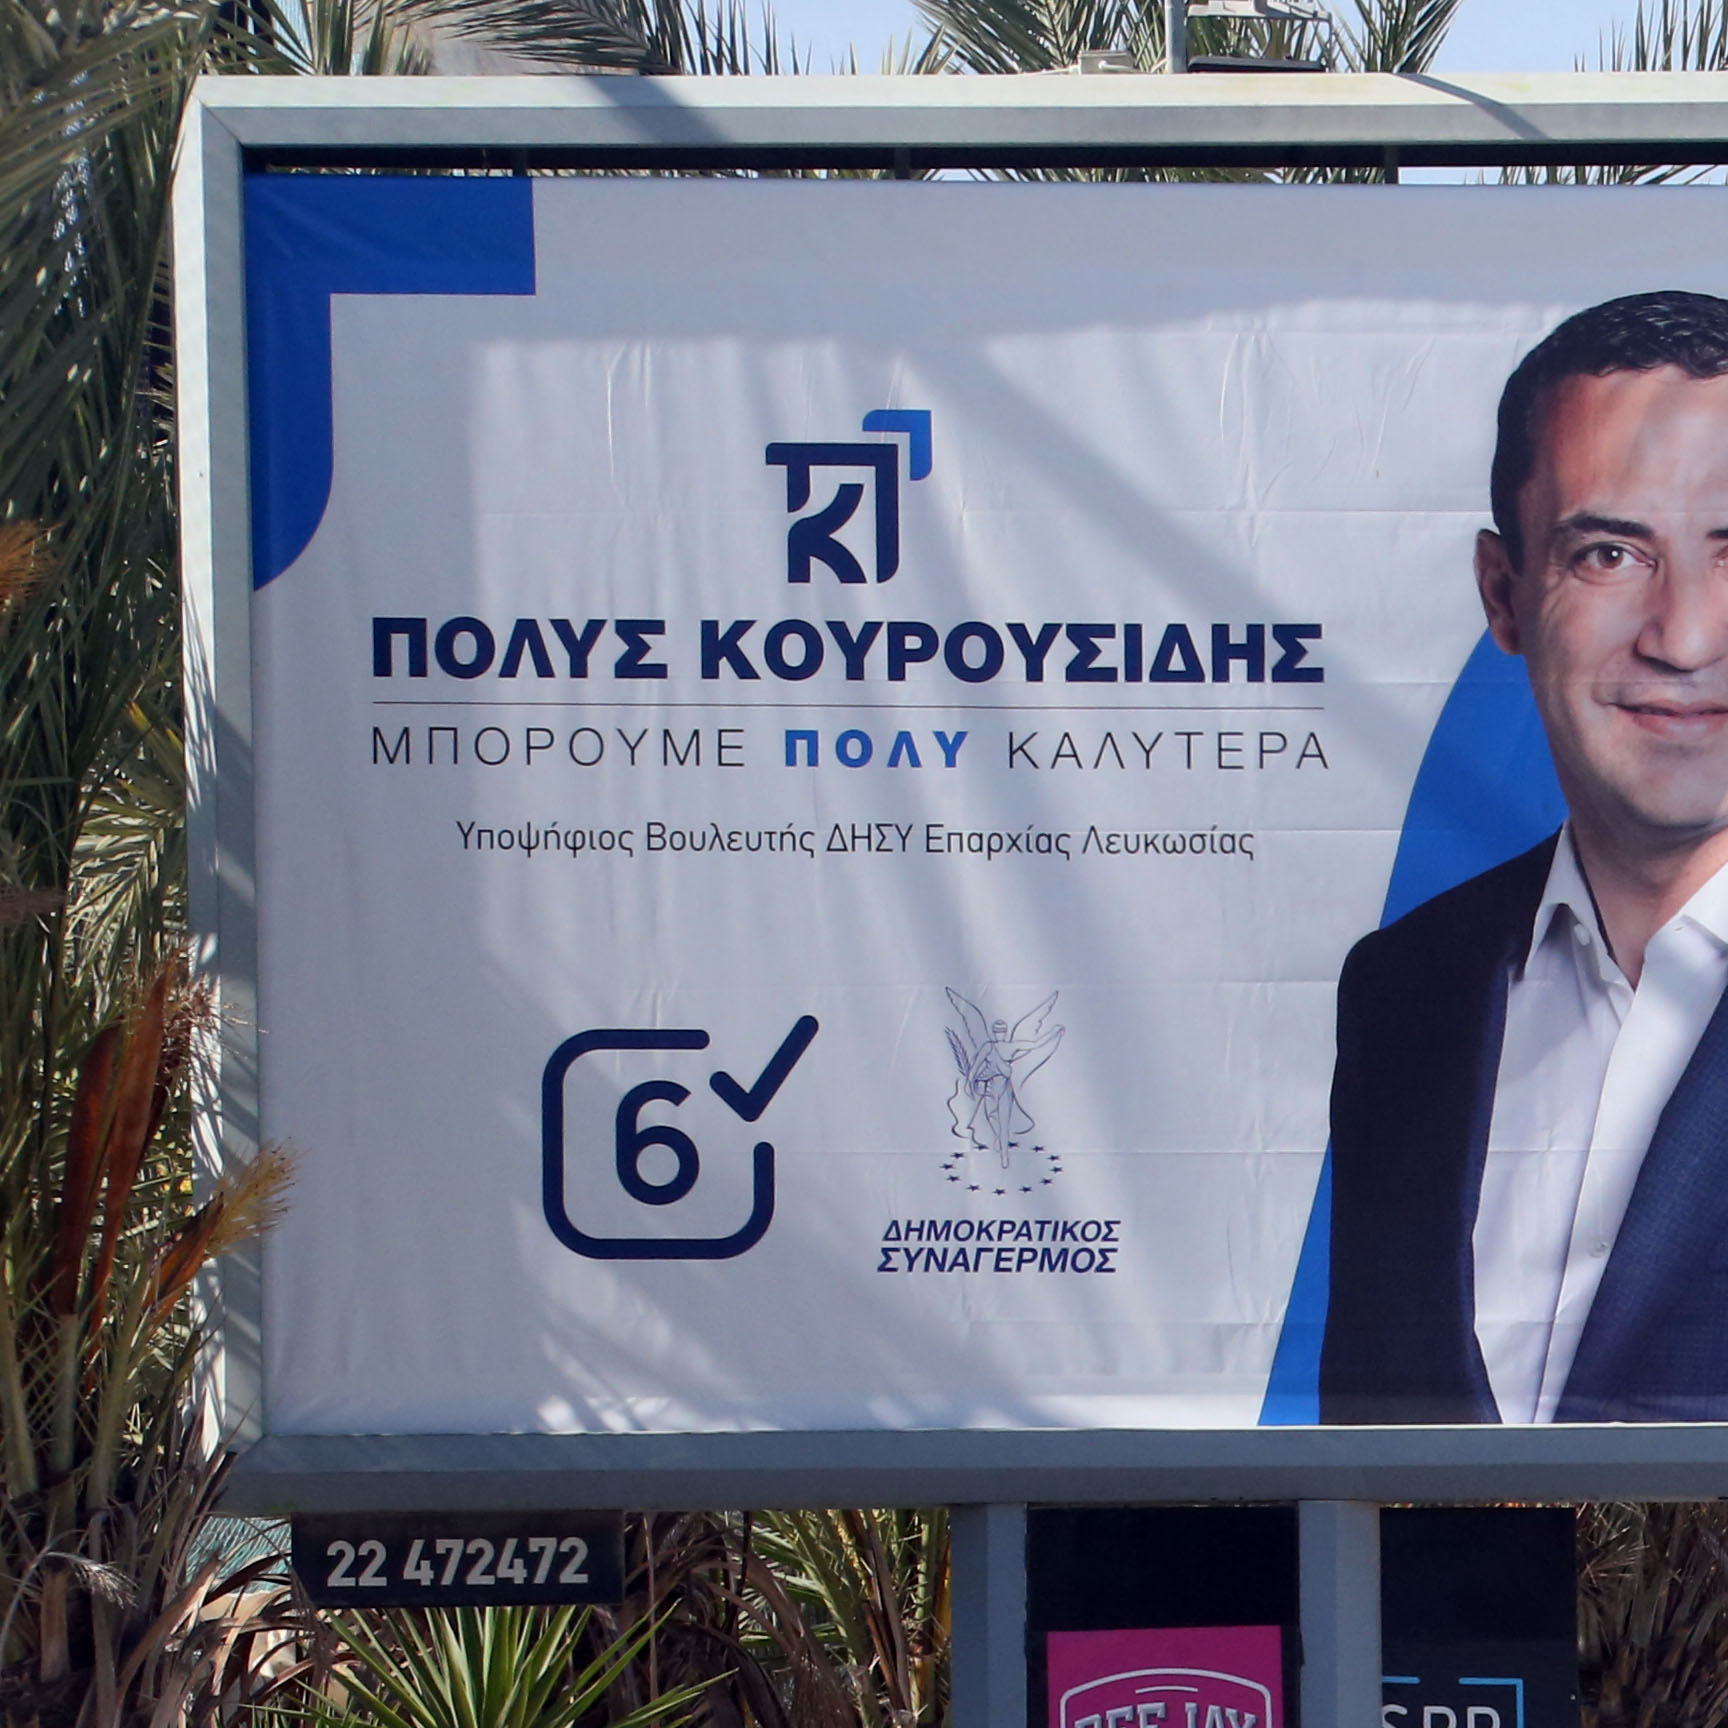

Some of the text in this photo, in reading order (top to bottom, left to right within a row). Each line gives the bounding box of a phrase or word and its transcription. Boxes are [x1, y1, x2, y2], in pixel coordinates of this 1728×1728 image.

[372, 617, 1325, 684] ΠΟΛΥΣ ΚΟΥΡΟΥΣΙΔΗΣ
[371, 726, 1330, 770] ΜΠΟΡΟΥΜΕ ΠΟΛΥ ΚΑΛΥΤΕΡΑ
[456, 820, 1255, 862] Υποψήφιος Βουλευτής ΔΗΣΥ Επαρχίας Λευκωσίας
[614, 1078, 701, 1206] 6
[881, 1219, 1122, 1243] ΔΗΜΟΚΡΑΤΙΚΟΣ
[876, 1246, 1118, 1275] ΣΥΝΑΓΕΡΜΟΣ
[326, 1536, 589, 1588] 22 472472
